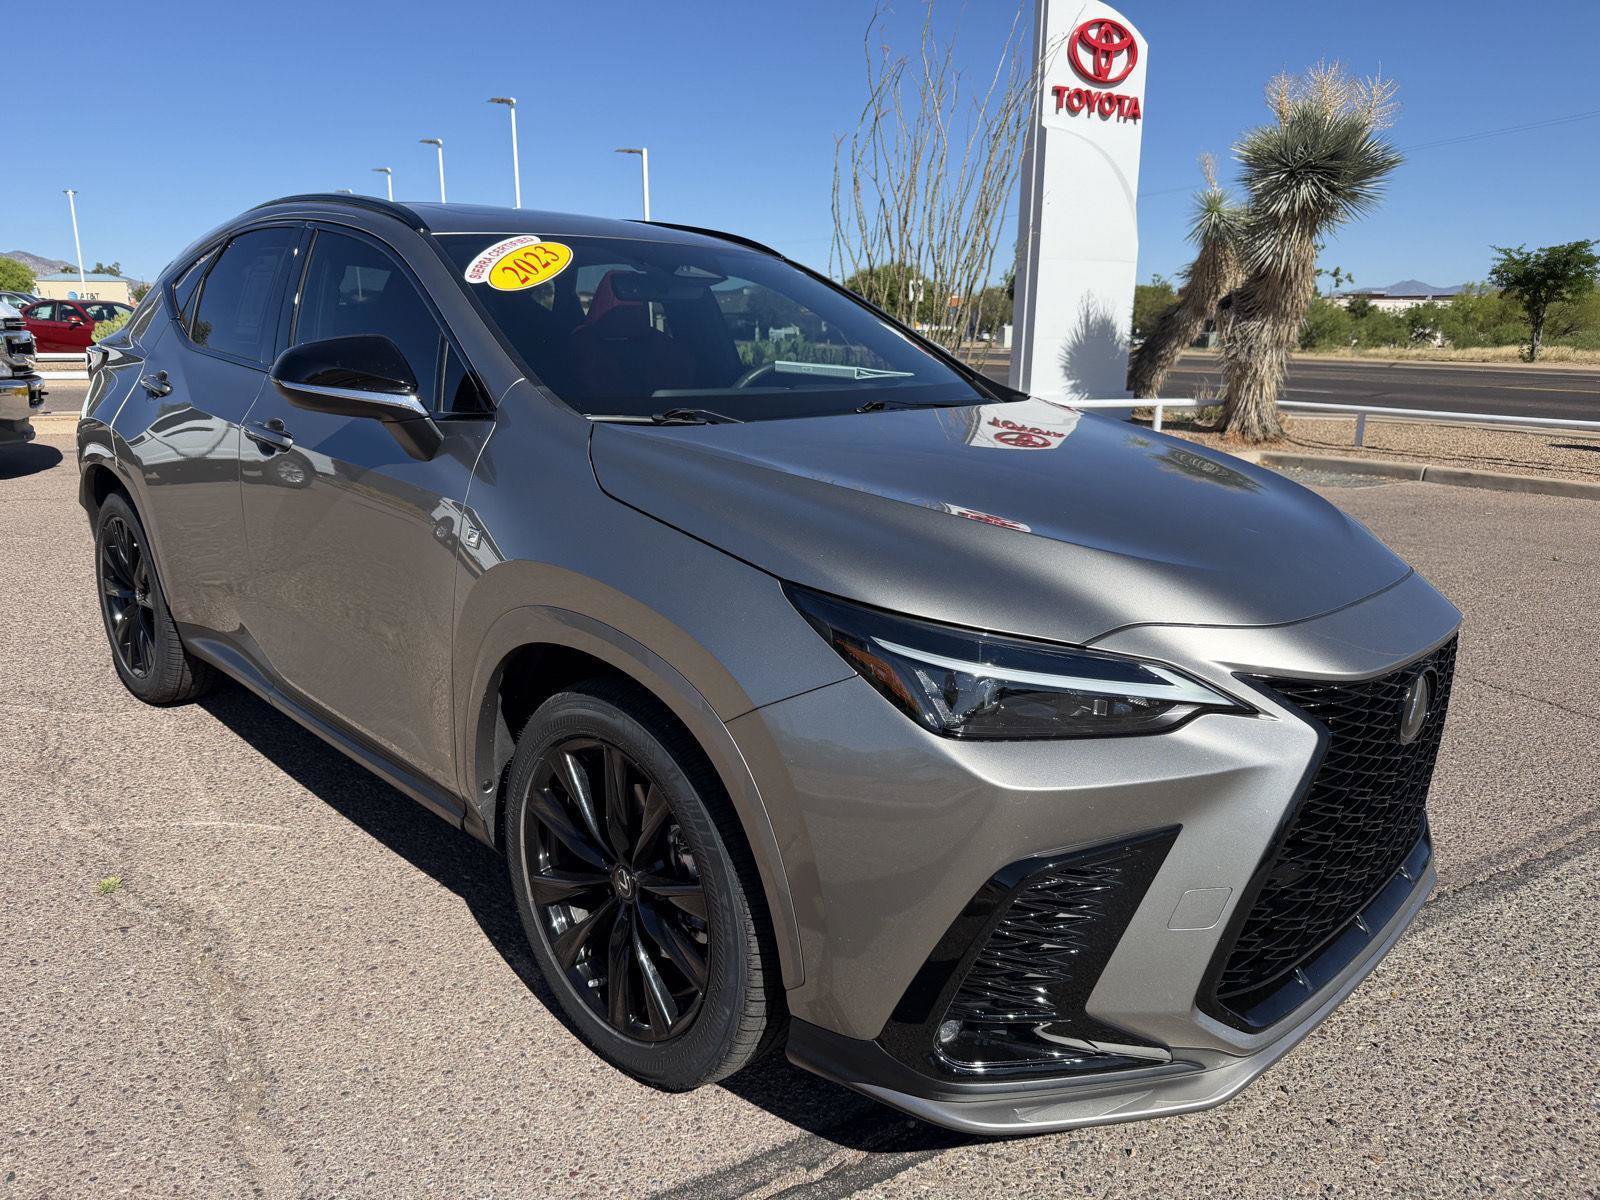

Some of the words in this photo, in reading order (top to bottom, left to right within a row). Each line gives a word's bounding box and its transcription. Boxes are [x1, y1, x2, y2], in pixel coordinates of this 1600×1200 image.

[1052, 86, 1141, 121] TOYOTA
[469, 257, 492, 279] SIERRA
[489, 237, 534, 257] CERTIFIED
[501, 246, 560, 285] 2023
[80, 292, 100, 300] AT&T
